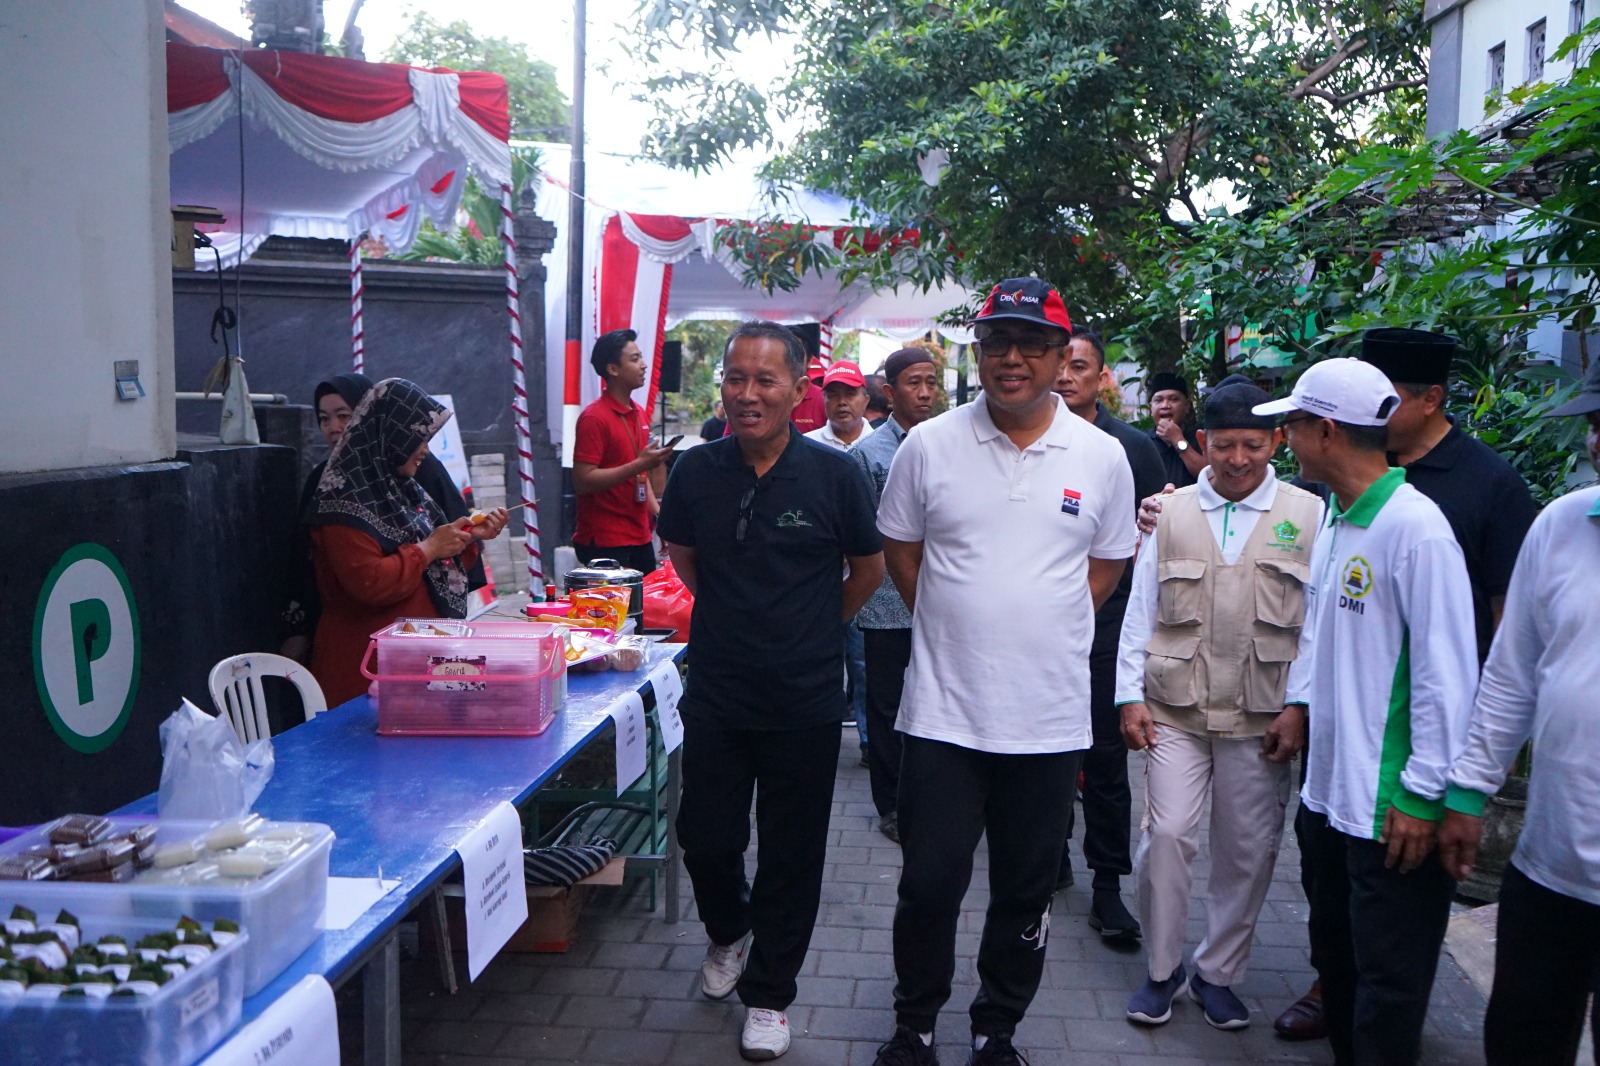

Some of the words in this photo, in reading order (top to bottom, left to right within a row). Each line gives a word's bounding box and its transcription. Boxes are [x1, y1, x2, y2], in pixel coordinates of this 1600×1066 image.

[1063, 496, 1080, 507] FILA
[1339, 595, 1366, 615] DMI
[69, 598, 112, 706] P
